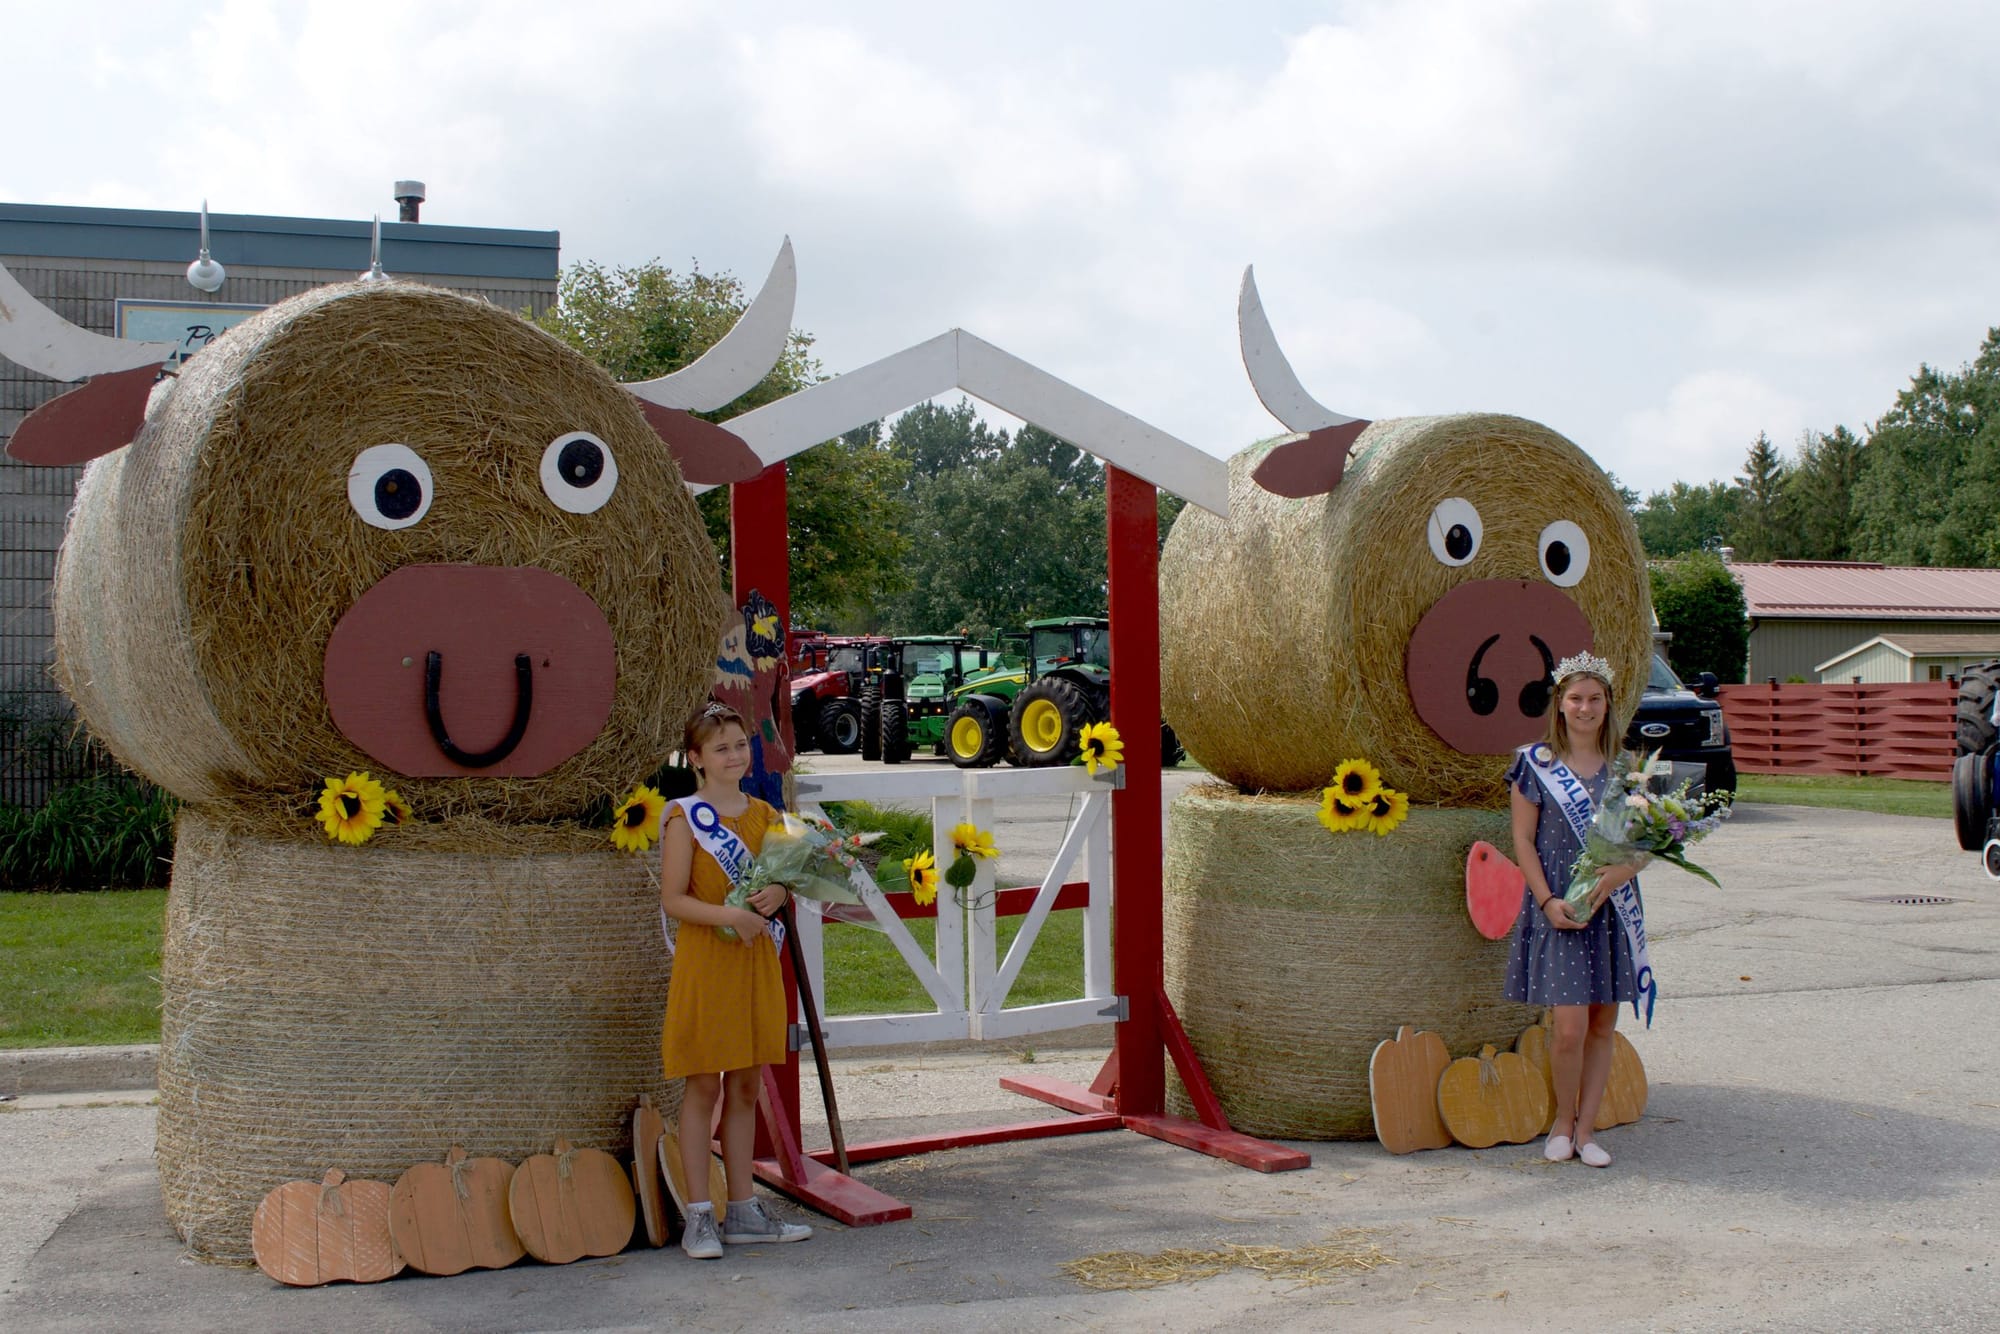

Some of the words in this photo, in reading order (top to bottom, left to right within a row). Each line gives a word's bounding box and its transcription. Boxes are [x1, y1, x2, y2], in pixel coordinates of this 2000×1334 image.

[1550, 765, 1591, 820] PALM
[709, 826, 748, 868] PAL
[714, 848, 741, 885] JUNIO
[1618, 903, 1632, 928] 2020
[1629, 904, 1646, 954] FAIR
